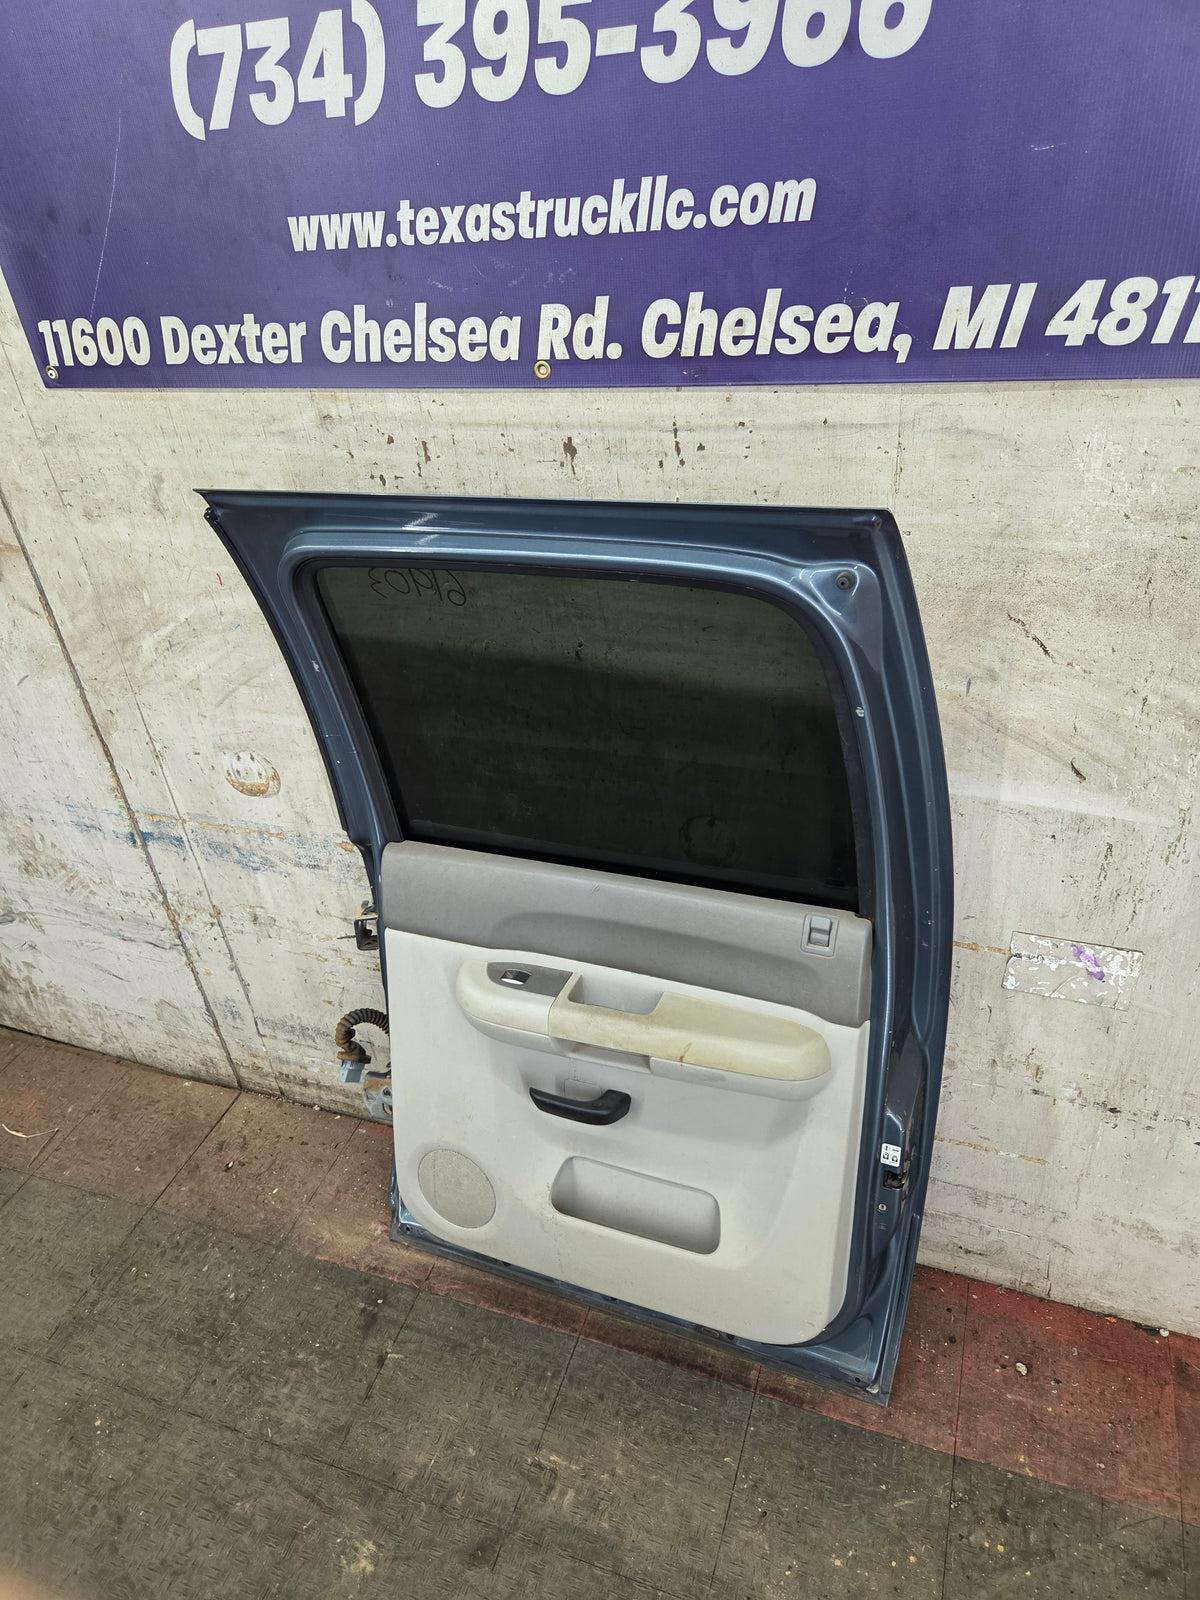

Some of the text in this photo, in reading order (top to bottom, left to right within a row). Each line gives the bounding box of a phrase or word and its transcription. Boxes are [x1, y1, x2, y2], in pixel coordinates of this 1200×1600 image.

[170, 0, 386, 141] (734)
[287, 175, 817, 251] www.texastruckllc.com
[38, 316, 151, 367] 11600
[160, 313, 306, 365] Dexter
[320, 302, 521, 364] Chelsea
[537, 295, 623, 361] Rd.
[641, 288, 912, 363] Chelsea,
[932, 282, 1038, 350] MI
